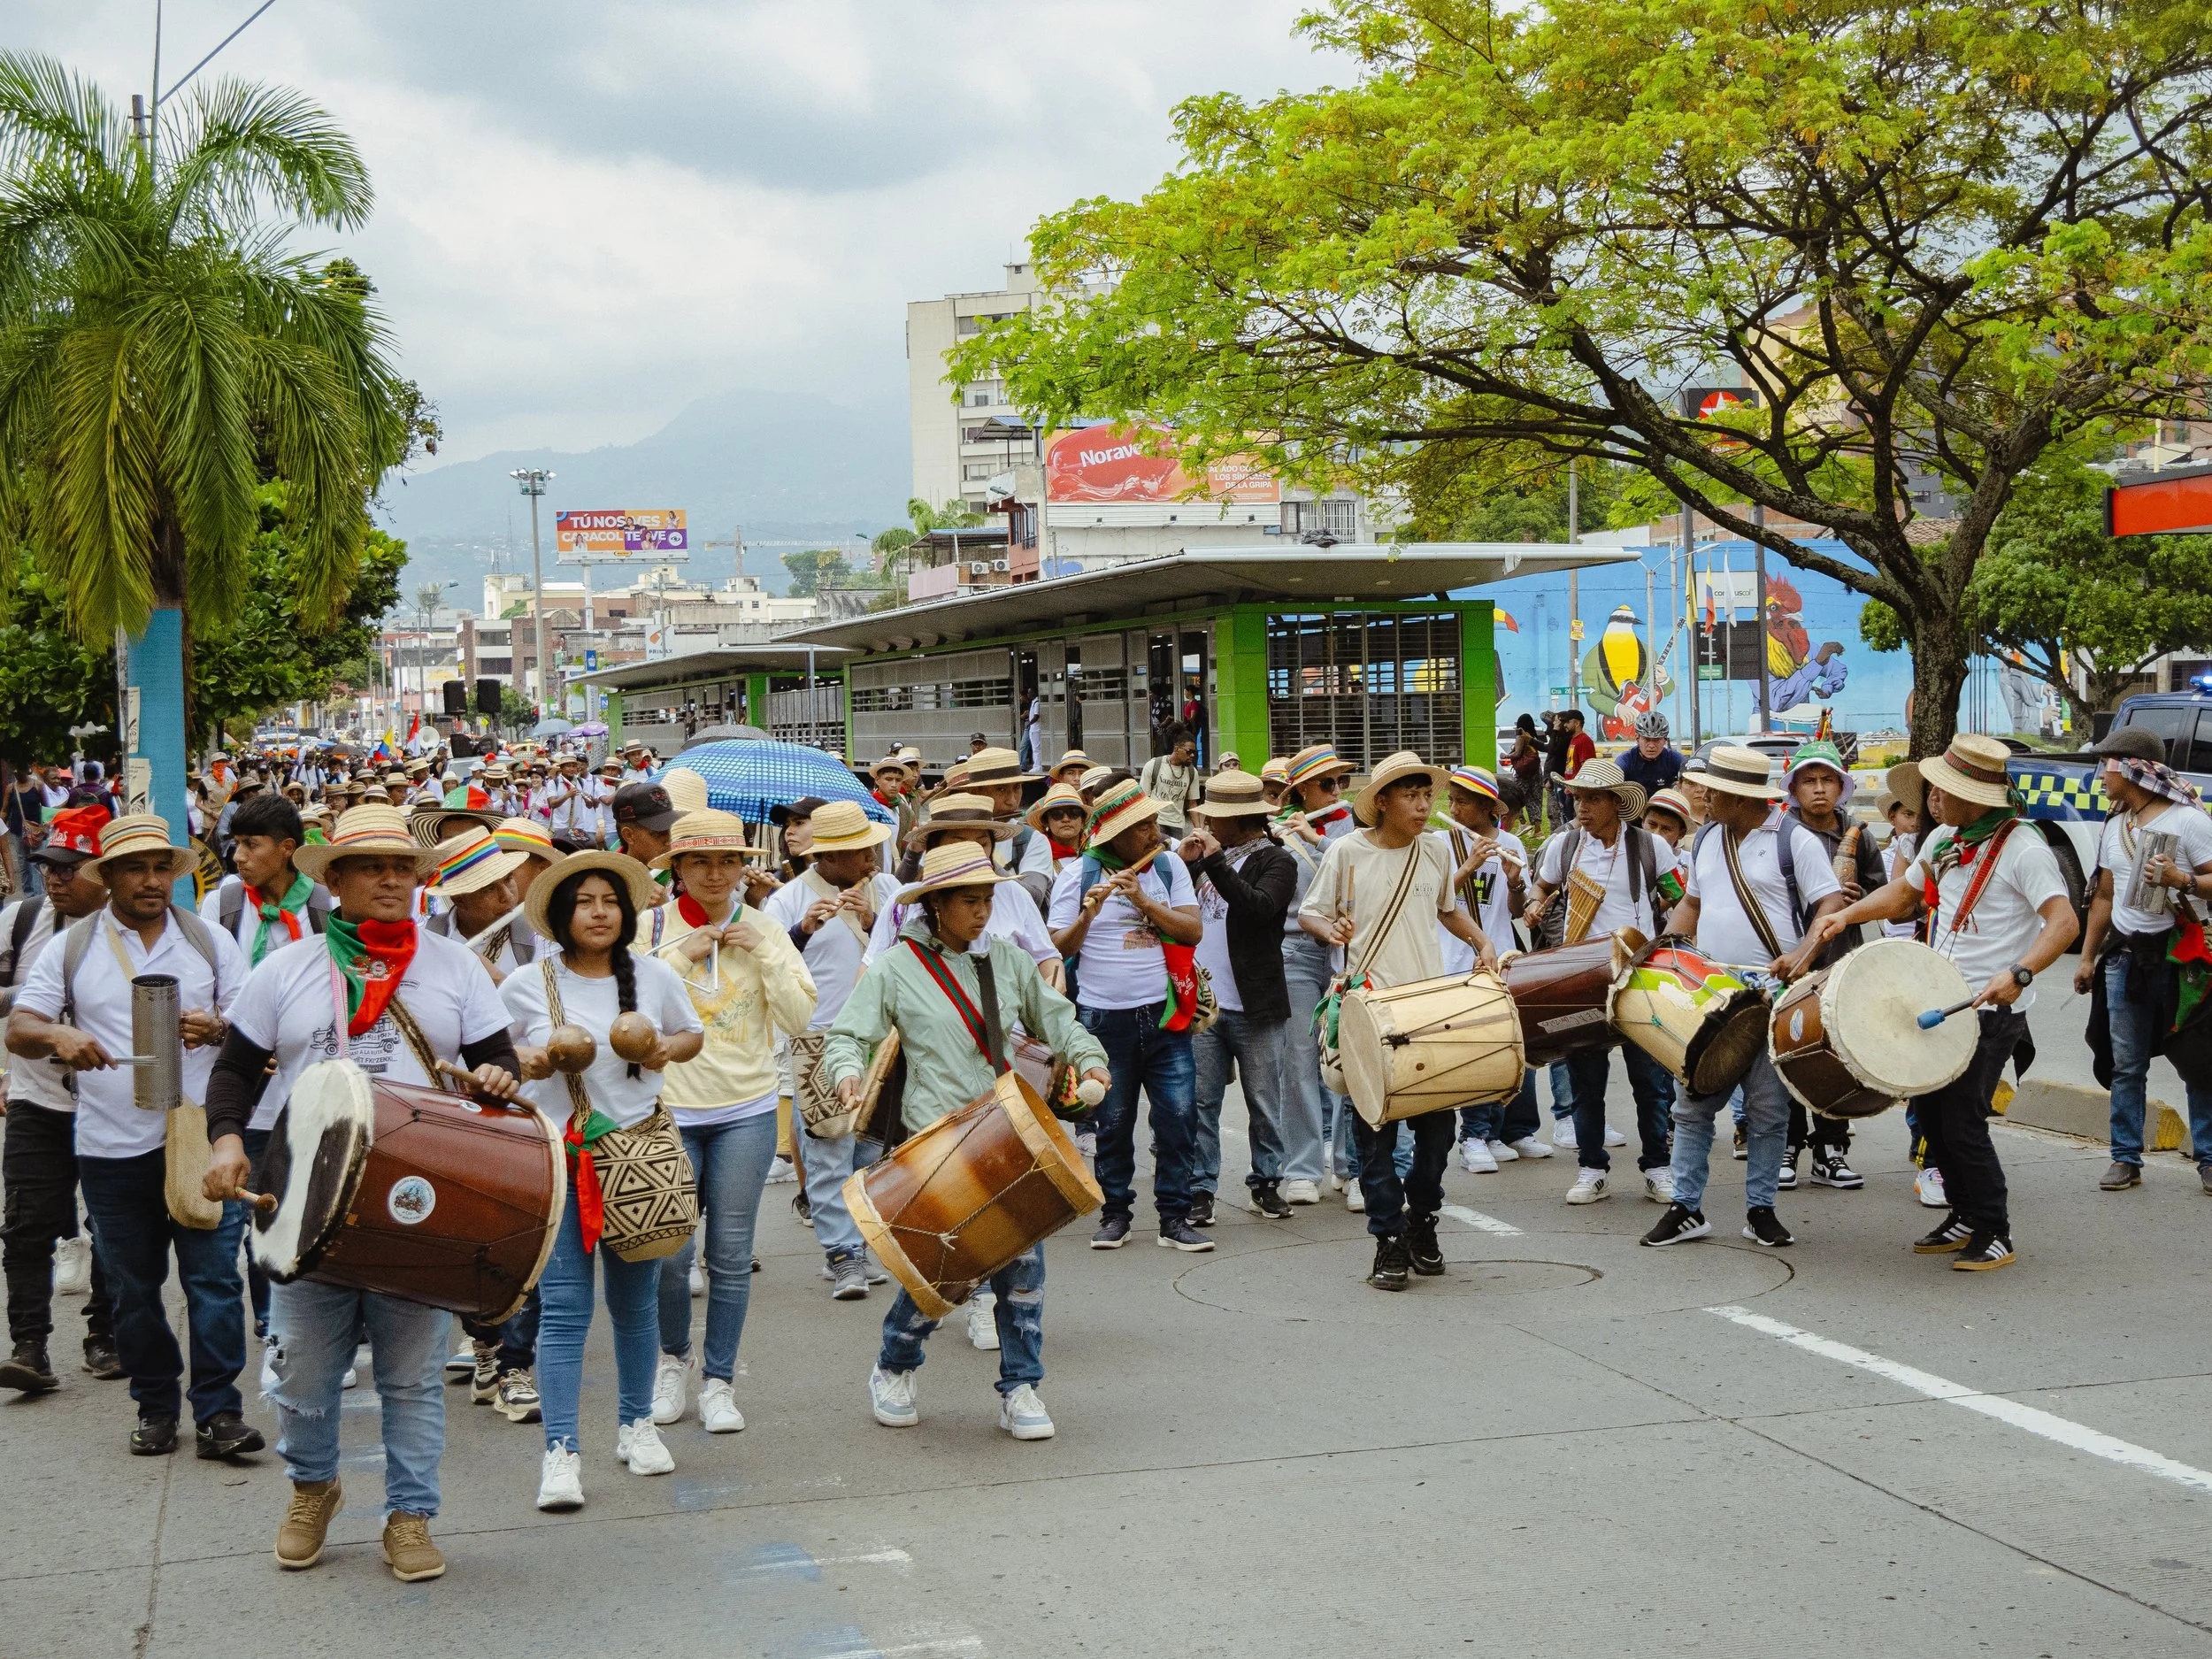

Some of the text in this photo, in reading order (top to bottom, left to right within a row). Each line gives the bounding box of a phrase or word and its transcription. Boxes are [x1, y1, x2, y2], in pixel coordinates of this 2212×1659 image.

[1079, 442, 1143, 468] Norave
[570, 513, 660, 528] TÚ NOS VES
[562, 531, 624, 541] CARACOL
[625, 531, 641, 541] TE
